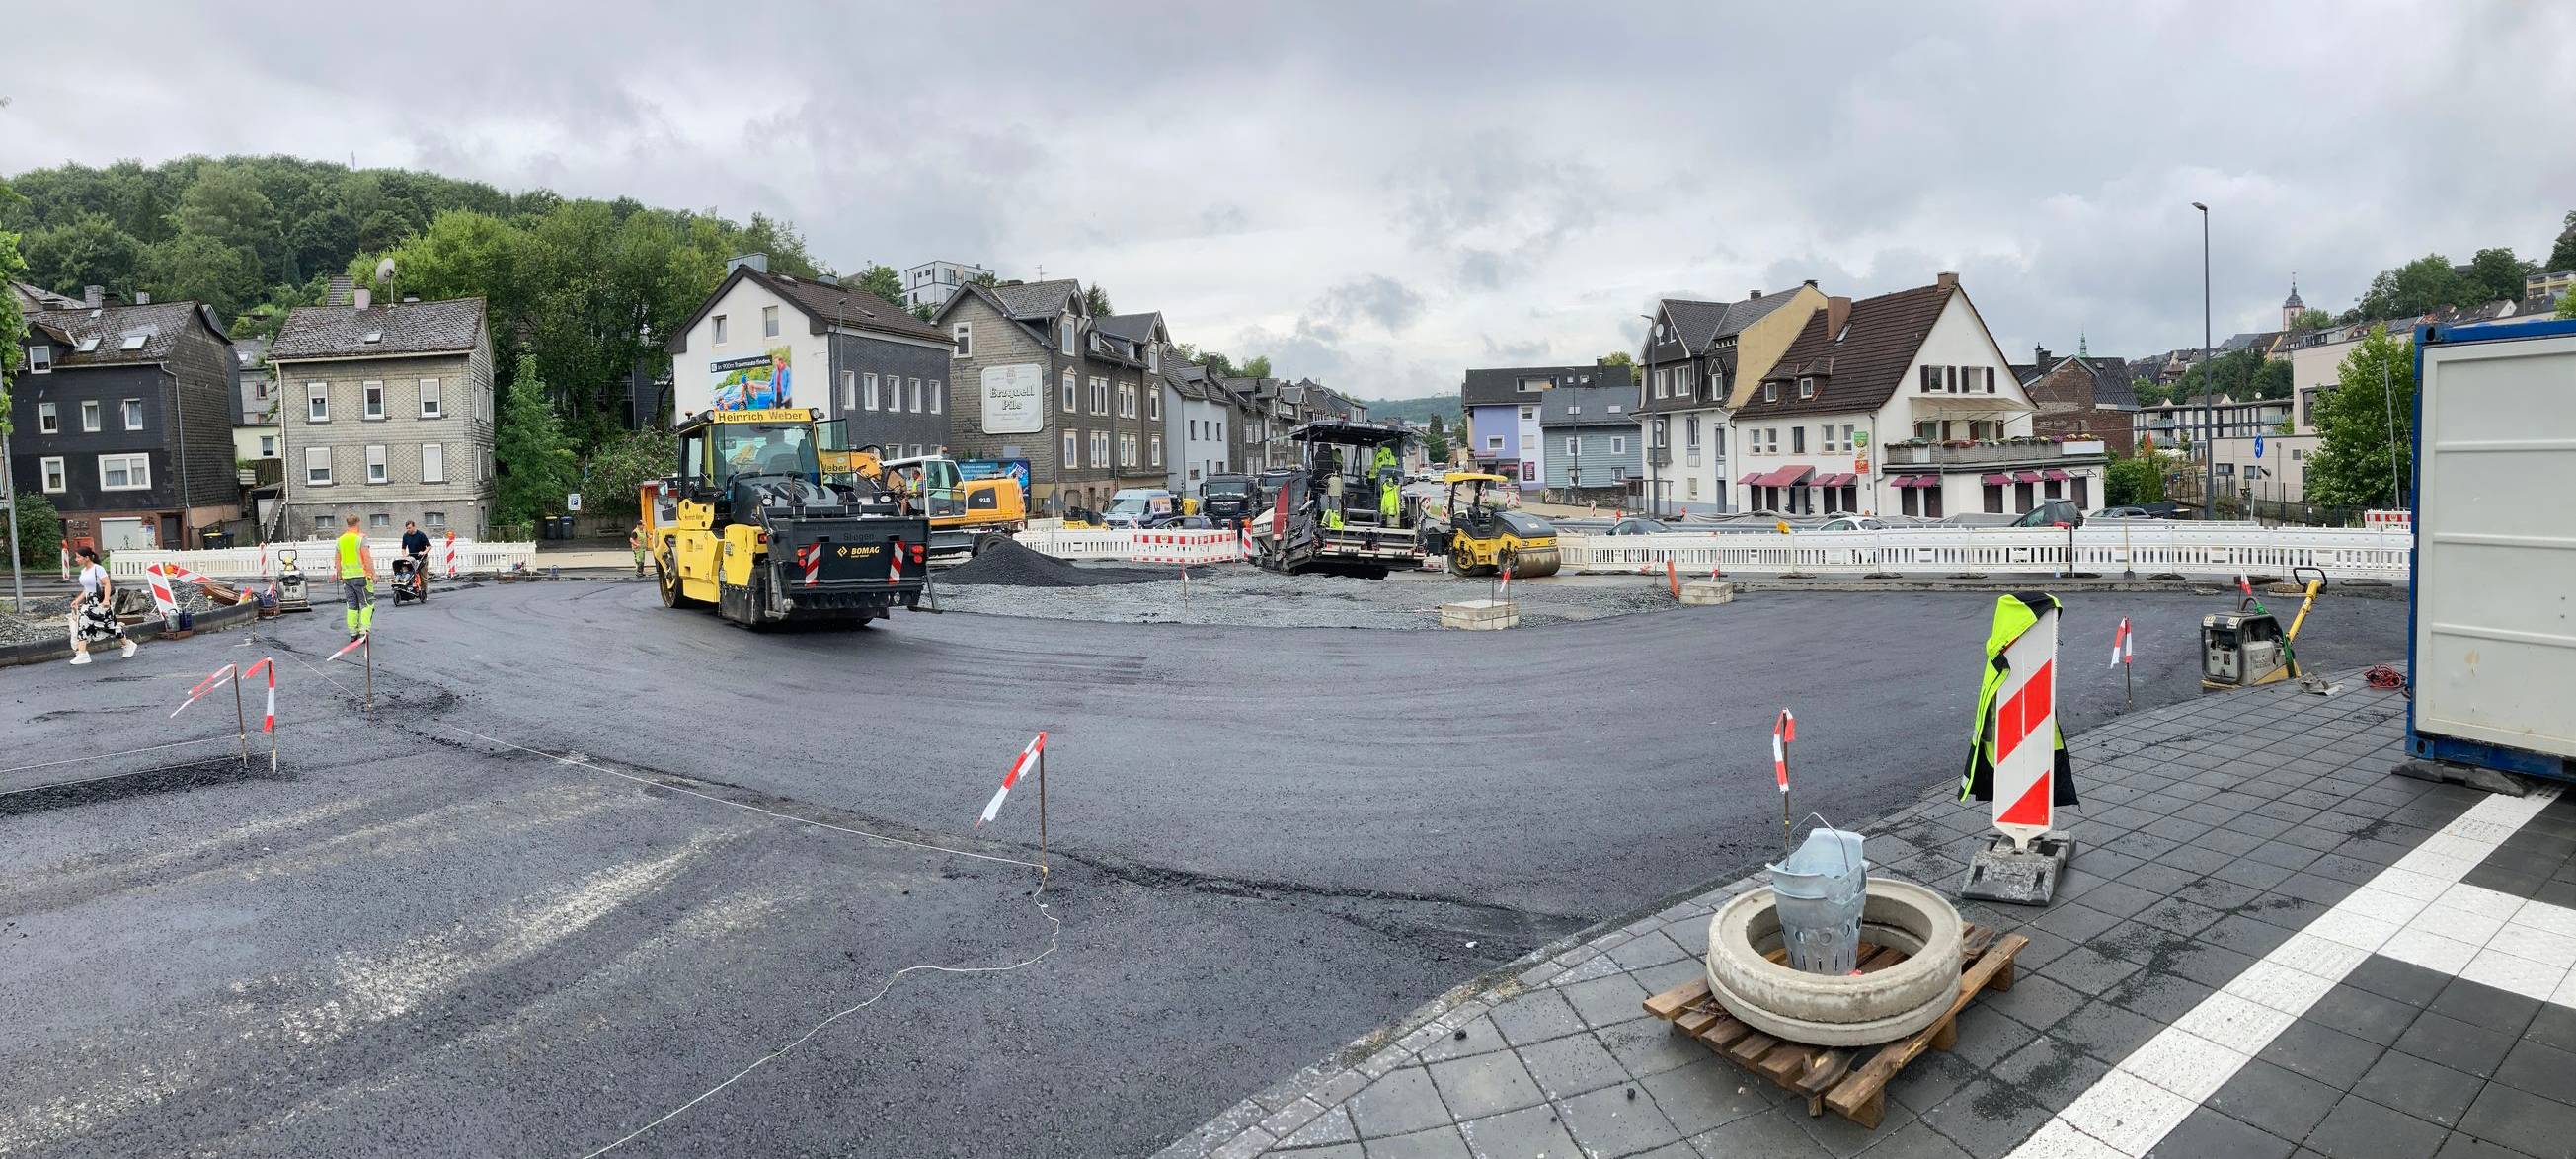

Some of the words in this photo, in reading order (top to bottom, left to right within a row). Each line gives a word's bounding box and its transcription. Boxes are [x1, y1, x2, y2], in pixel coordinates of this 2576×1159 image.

[1002, 399, 1023, 411] Pils
[718, 411, 763, 422] Heinrich
[769, 410, 802, 420] Weber
[851, 545, 881, 555] BOMAG
